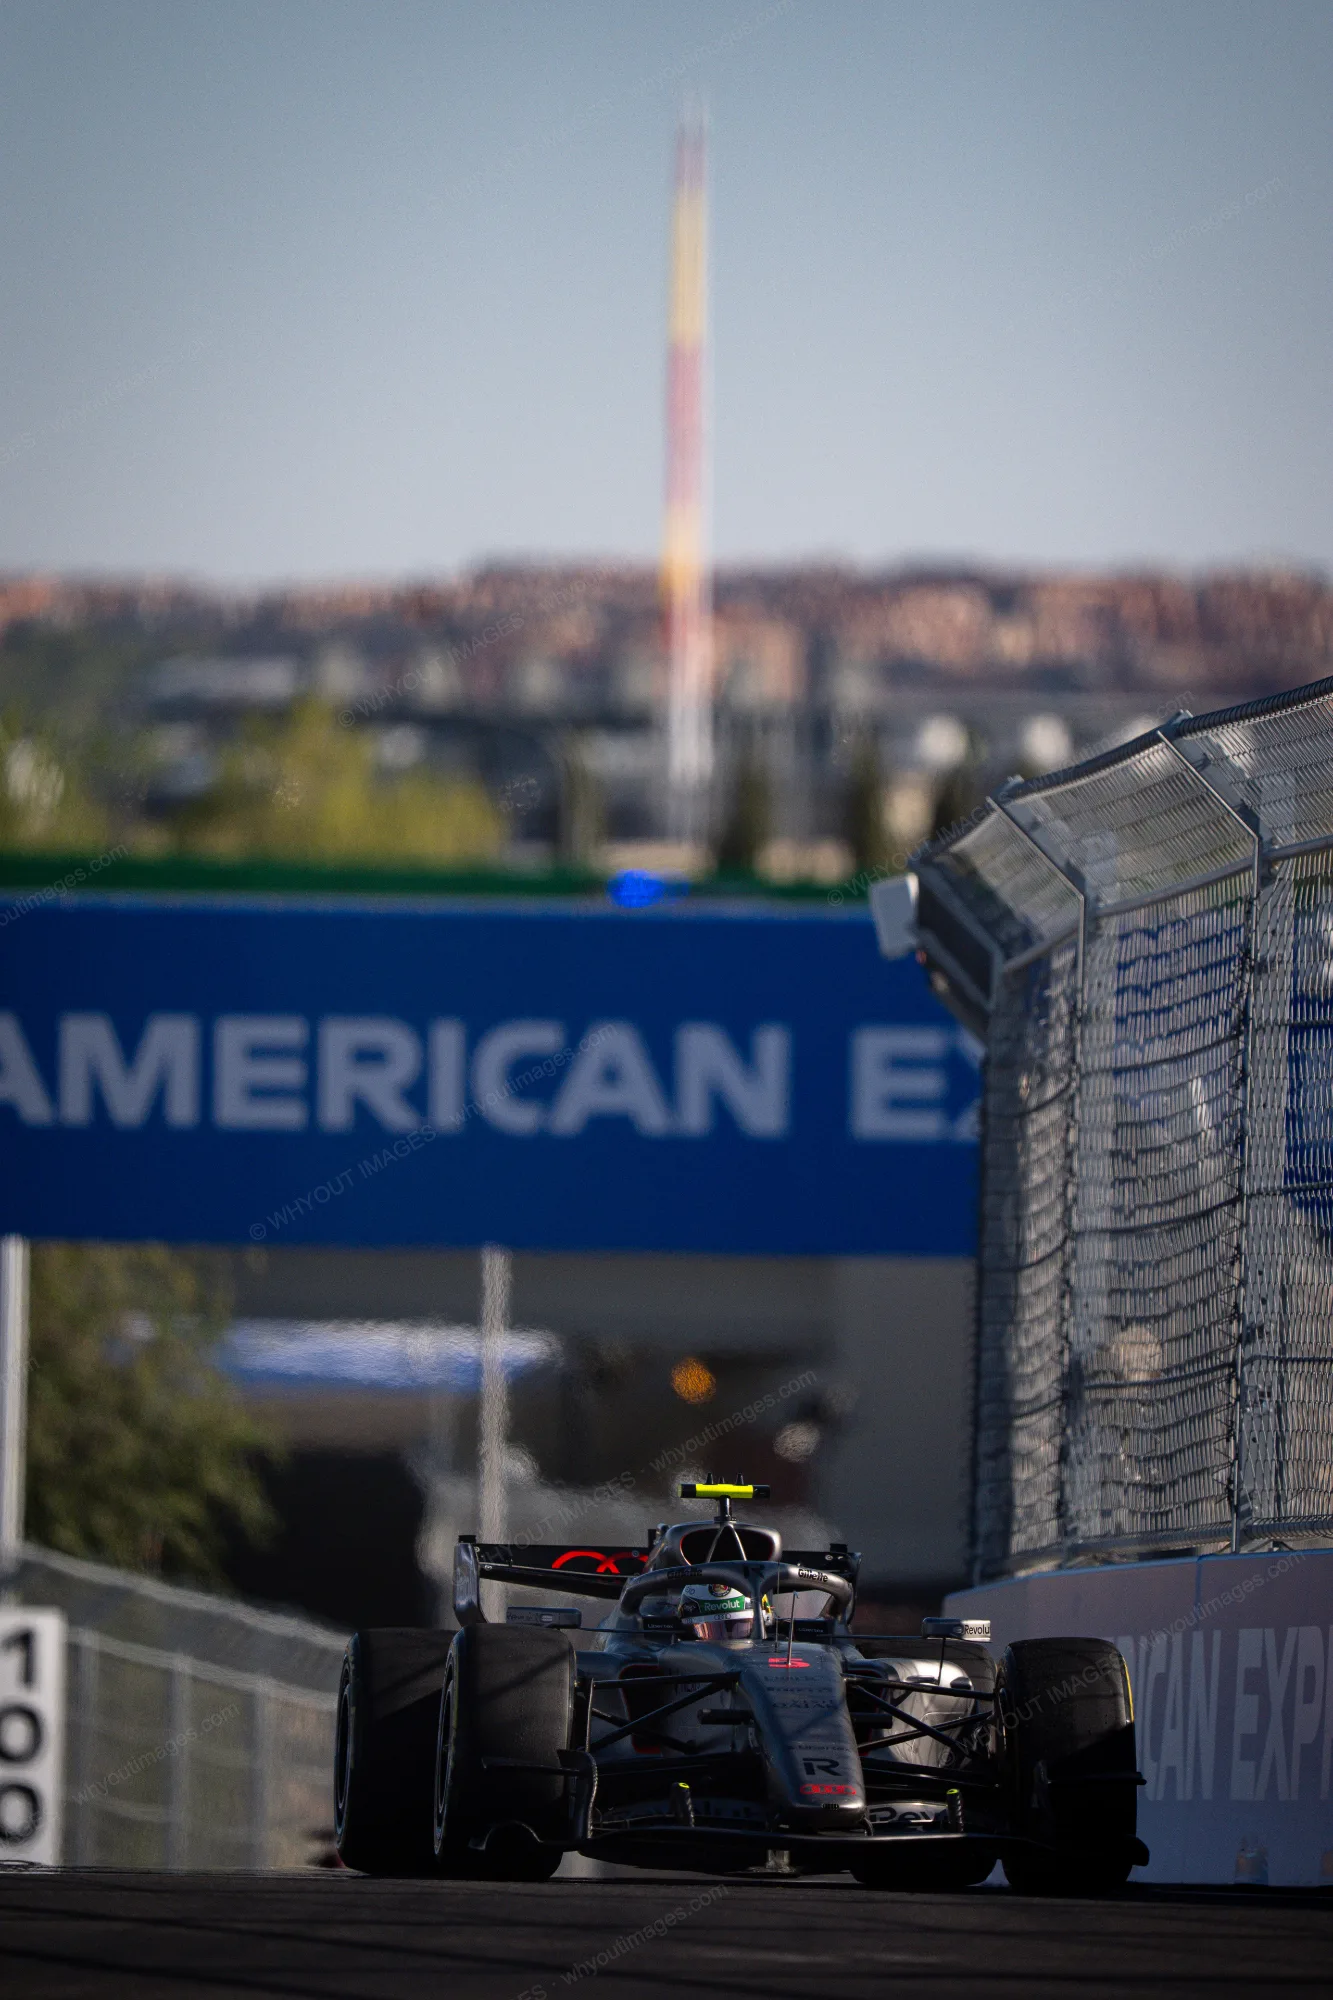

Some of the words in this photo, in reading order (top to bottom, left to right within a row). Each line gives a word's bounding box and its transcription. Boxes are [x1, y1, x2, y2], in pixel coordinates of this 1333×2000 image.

[797, 1568, 829, 1583] Gillette
[704, 1599, 741, 1612] Revolut
[964, 1624, 990, 1635] Revolu
[1116, 1628, 1222, 1800] ICAN
